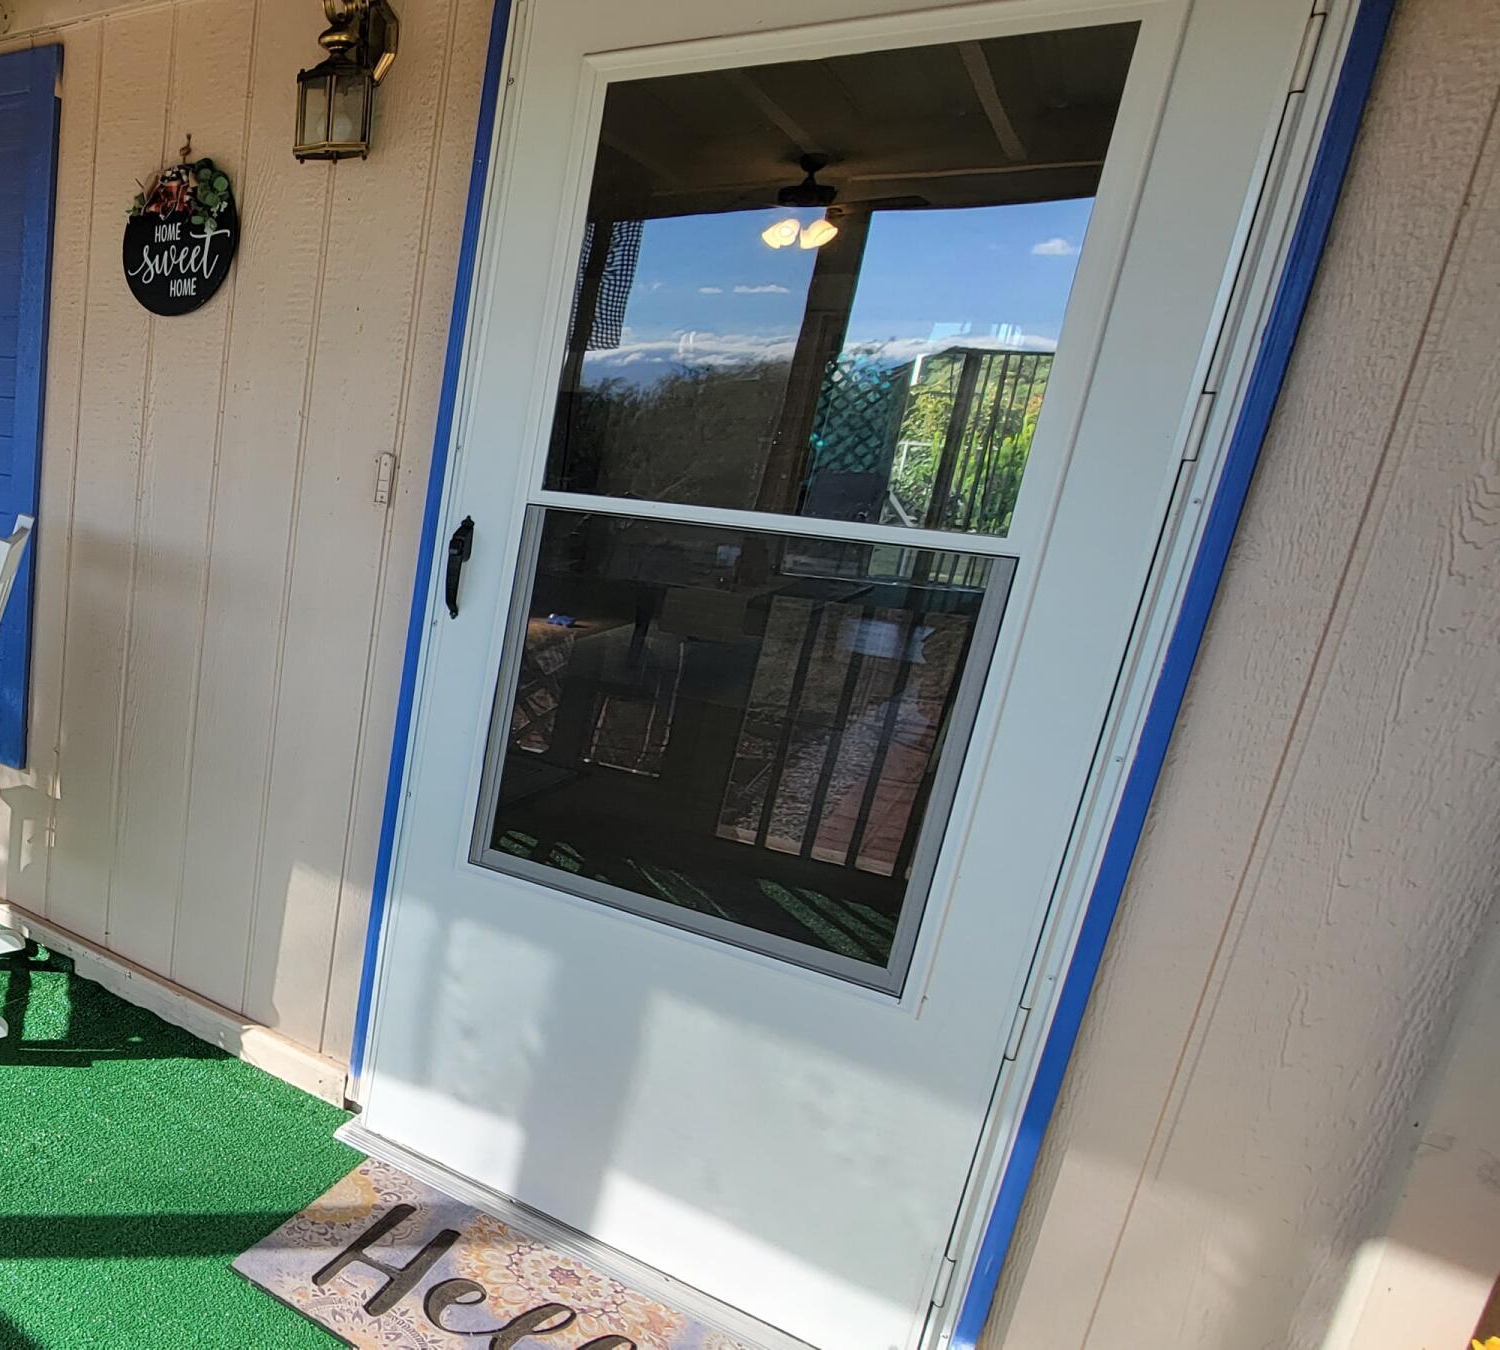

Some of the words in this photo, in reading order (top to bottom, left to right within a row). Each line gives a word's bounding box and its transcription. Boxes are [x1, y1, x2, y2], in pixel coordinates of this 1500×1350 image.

[154, 222, 182, 243] HOME
[128, 228, 231, 284] sweet
[169, 277, 198, 298] HOME
